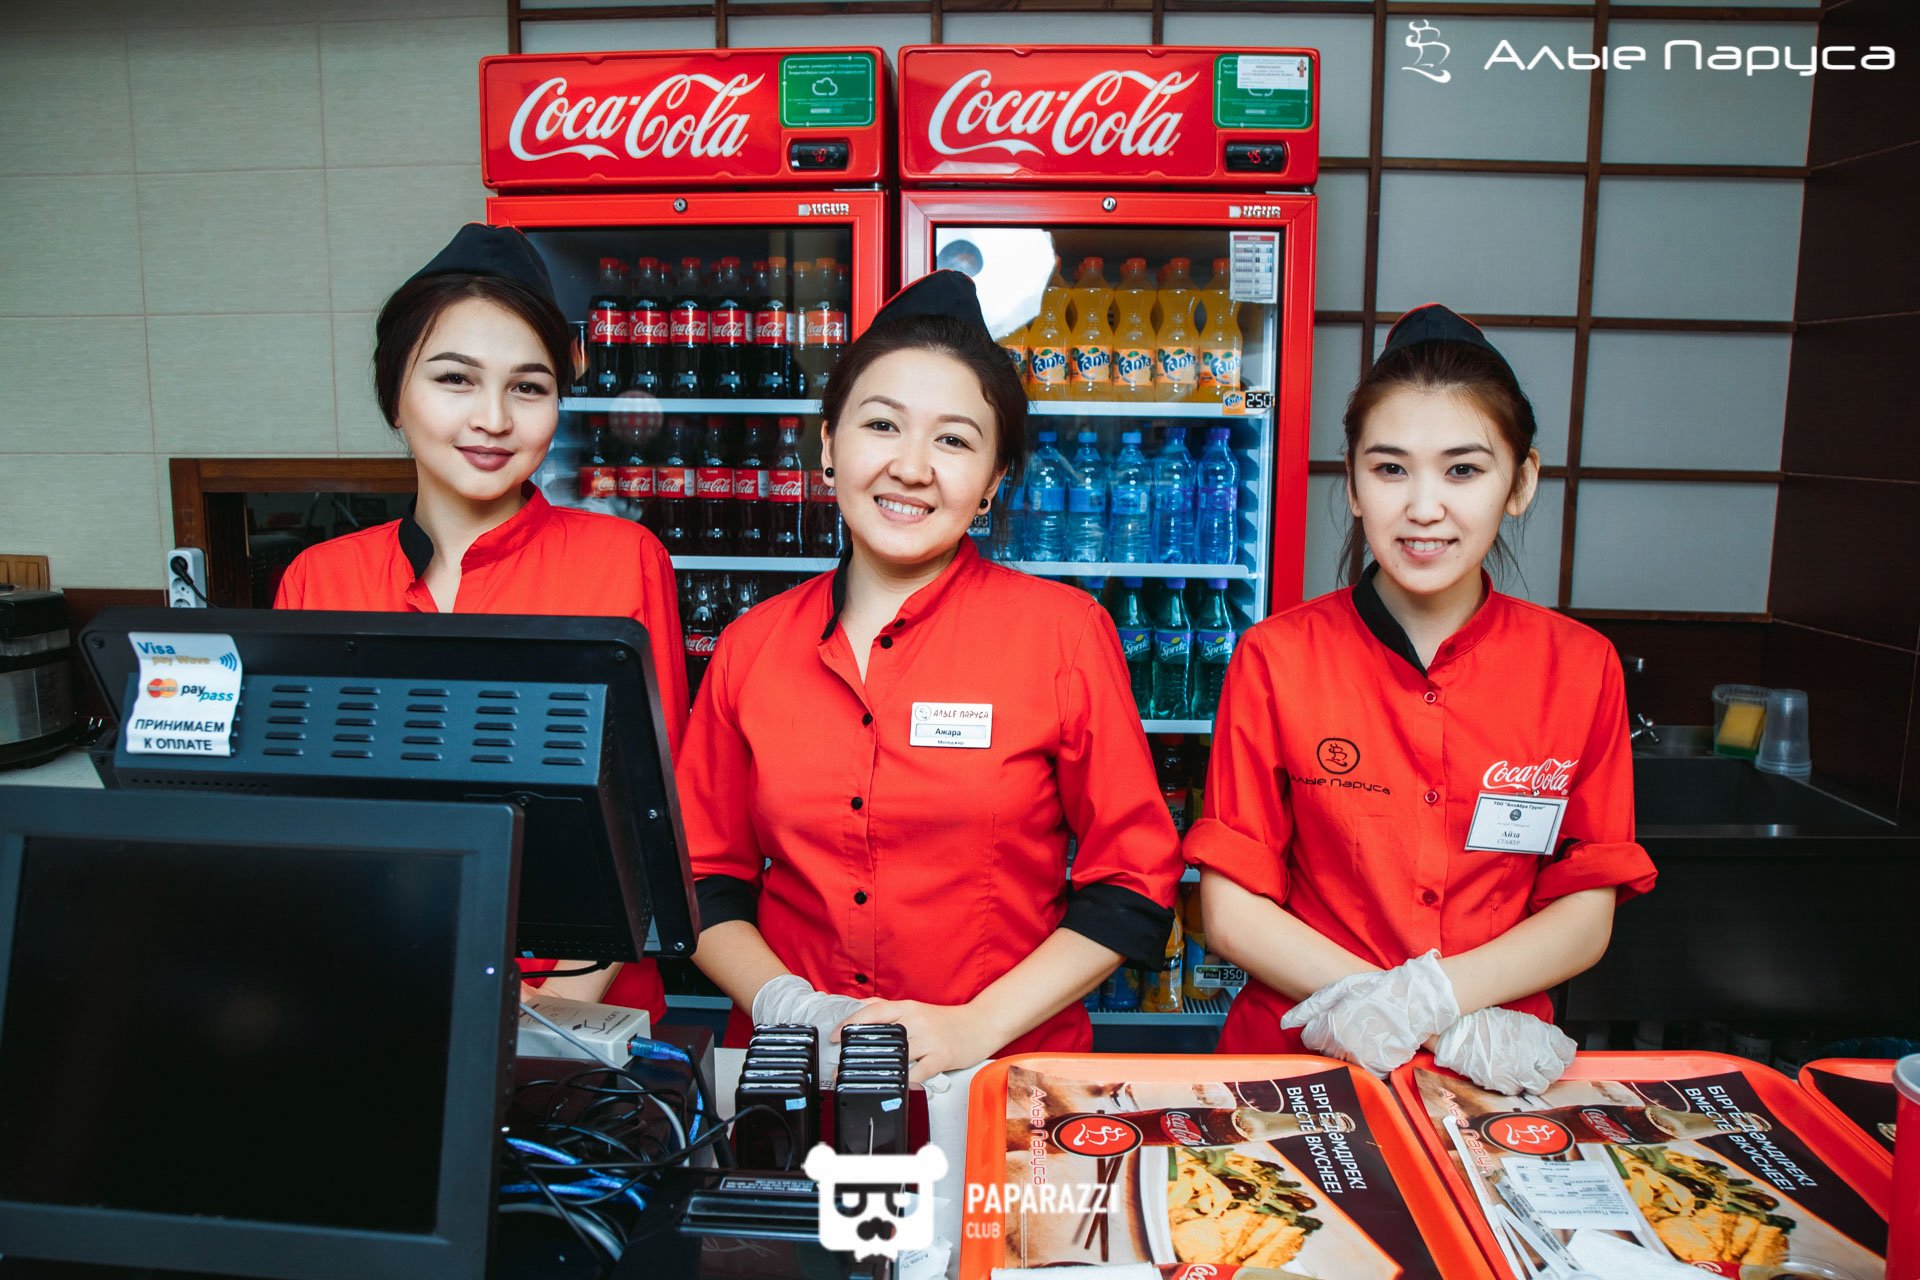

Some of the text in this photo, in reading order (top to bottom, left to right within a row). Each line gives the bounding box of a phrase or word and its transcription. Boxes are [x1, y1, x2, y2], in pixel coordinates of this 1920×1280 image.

[509, 73, 766, 161] Coca-Cola
[928, 69, 1200, 156] Coca-Cola
[811, 203, 849, 216] UGUR
[1243, 205, 1281, 219] UGUR
[137, 642, 176, 655] Visa
[181, 684, 206, 697] pay
[199, 691, 234, 702] pass
[134, 718, 225, 733] ПРИНИМАЕМ
[935, 727, 962, 738] Ажара
[144, 738, 213, 751] К ОПЛАТЕ
[1483, 758, 1579, 792] Coca-Cola
[1330, 778, 1391, 795] Паруса
[1222, 968, 1243, 980] 350
[1286, 1086, 1343, 1193] ВМЕСТЕ ВКУСНЕЕ!
[1685, 1087, 1796, 1190] ВМЕСТЕ ВКУСНЕЕ!
[1031, 1129, 1048, 1186] Паруса
